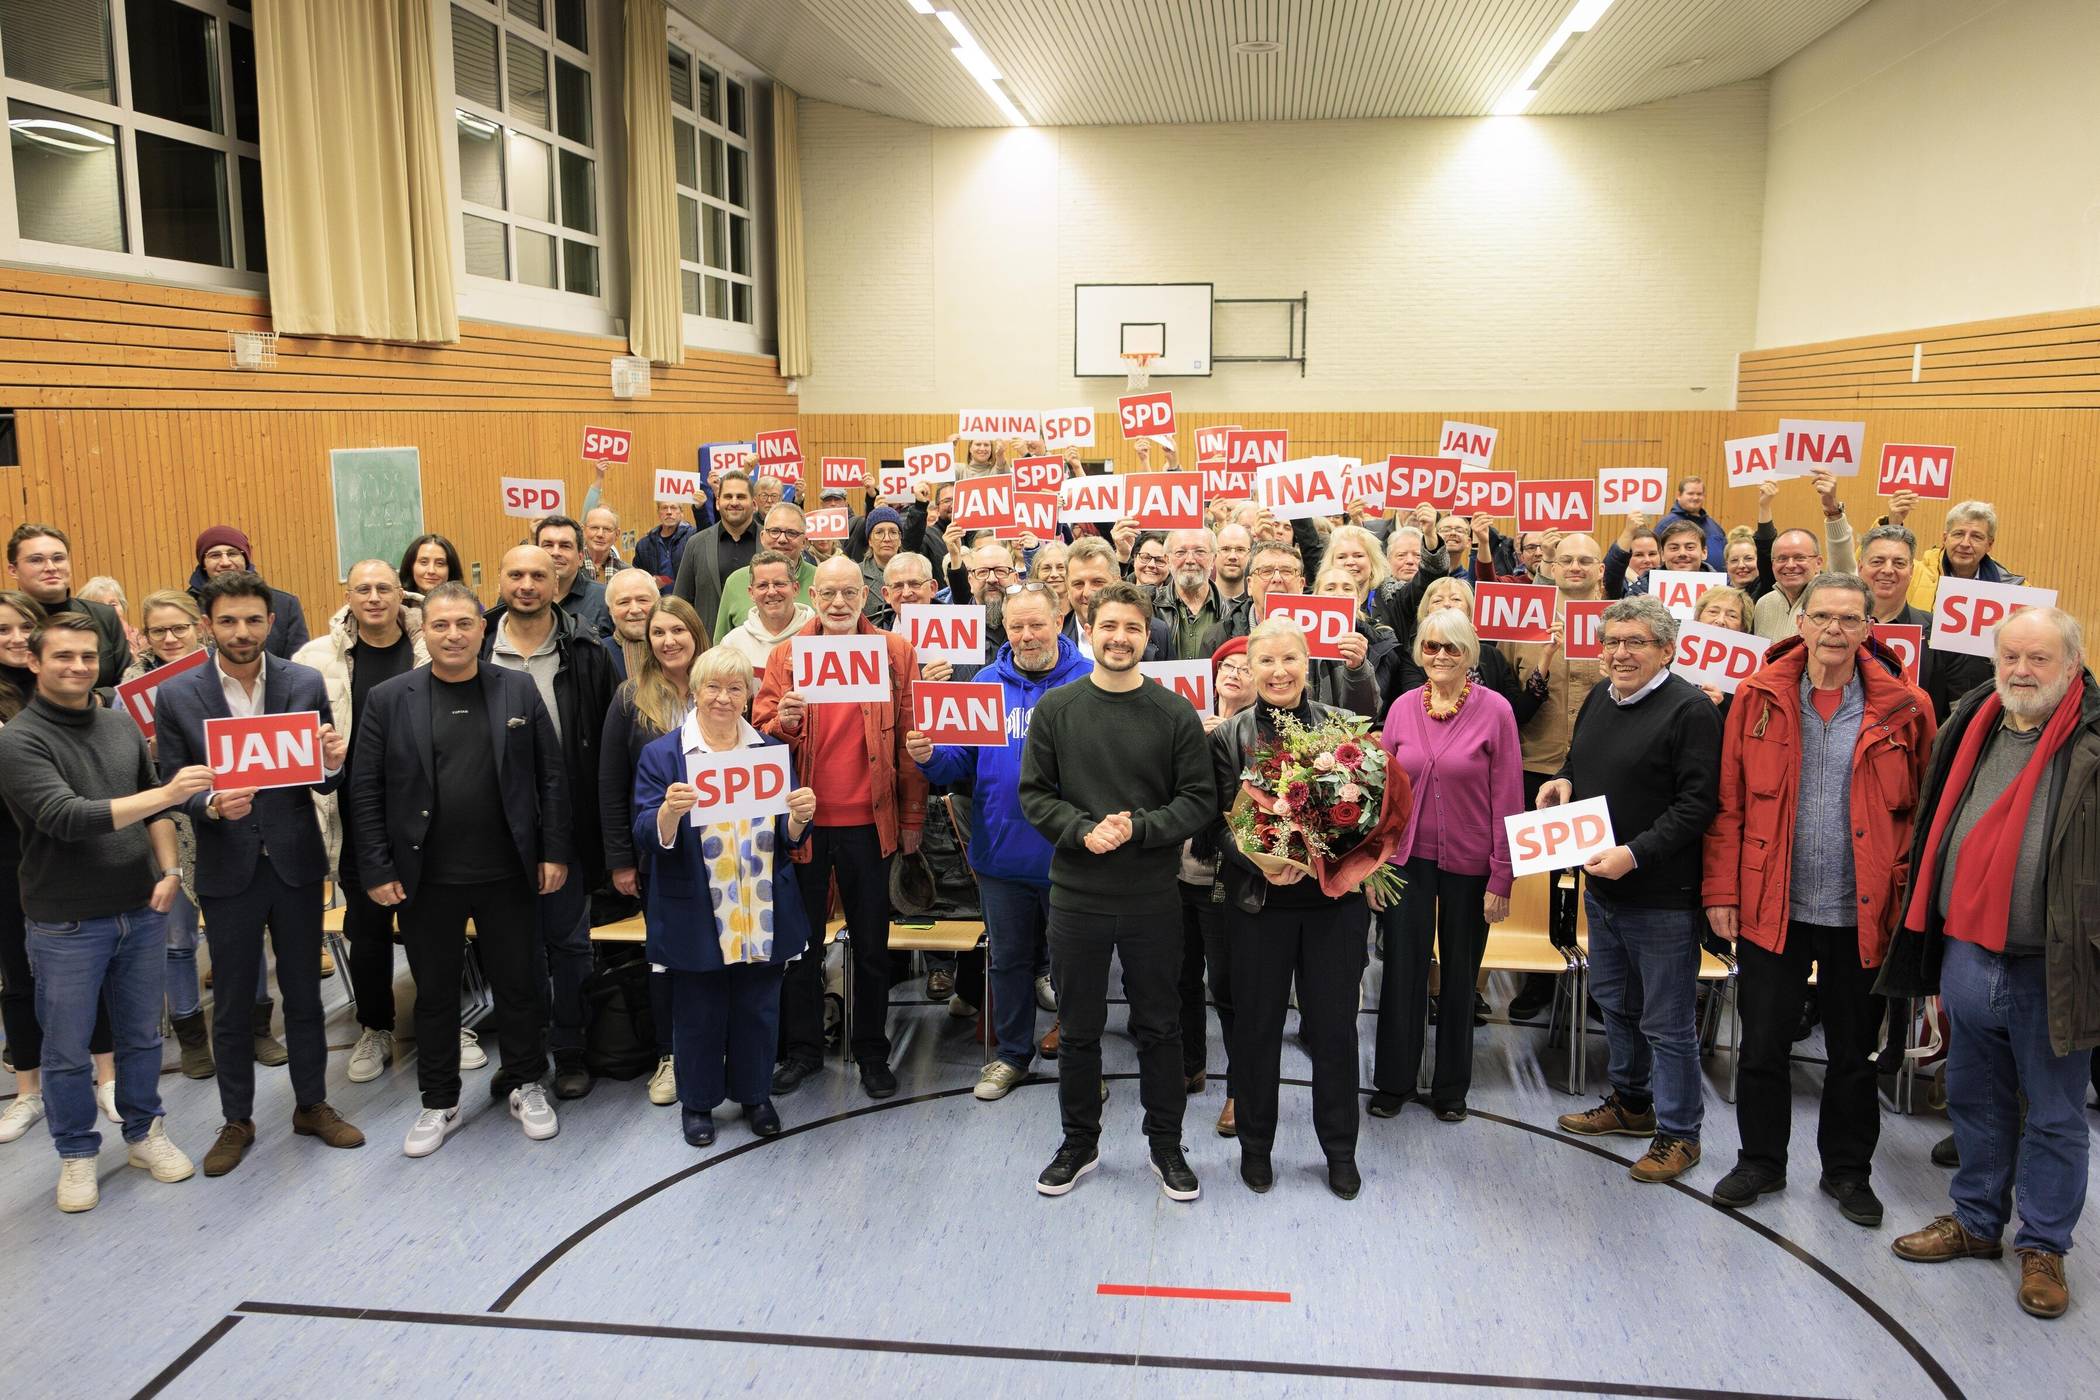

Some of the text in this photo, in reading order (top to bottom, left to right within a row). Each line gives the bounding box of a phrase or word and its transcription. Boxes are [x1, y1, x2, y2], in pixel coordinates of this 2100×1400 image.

[1046, 416, 1091, 440] SPD
[1121, 401, 1171, 429] SPD
[585, 434, 629, 456] SPD
[760, 437, 798, 459] INA
[1200, 433, 1228, 454] IN
[1229, 440, 1283, 464] JAN
[1443, 430, 1491, 457] JAN
[1784, 432, 1854, 463] INA
[826, 463, 862, 482] INA
[908, 452, 951, 476] SPD
[1017, 463, 1063, 488] SPD
[1881, 456, 1947, 487] JAN
[659, 477, 695, 495] INA
[883, 477, 914, 495] SP
[1203, 470, 1248, 491] INA
[1265, 470, 1335, 507] INA
[1390, 467, 1456, 499] SPD
[1455, 481, 1512, 507] SPD
[1603, 478, 1663, 503] SPD
[506, 487, 560, 510] SPD
[954, 486, 1010, 519] JAN
[1063, 486, 1118, 512] JAN
[1128, 485, 1198, 517] JAN
[1525, 491, 1589, 520] INA
[805, 514, 846, 533] SPD
[1014, 502, 1054, 529] AN
[1480, 595, 1548, 630] INA
[1940, 595, 2032, 637] SP
[910, 618, 977, 649] JAN
[798, 650, 881, 687] JAN
[1677, 634, 1758, 680] SPD
[919, 696, 999, 732] JAN
[215, 728, 315, 775] JAN
[695, 763, 785, 808] SPD
[1515, 814, 1606, 861] SPD
